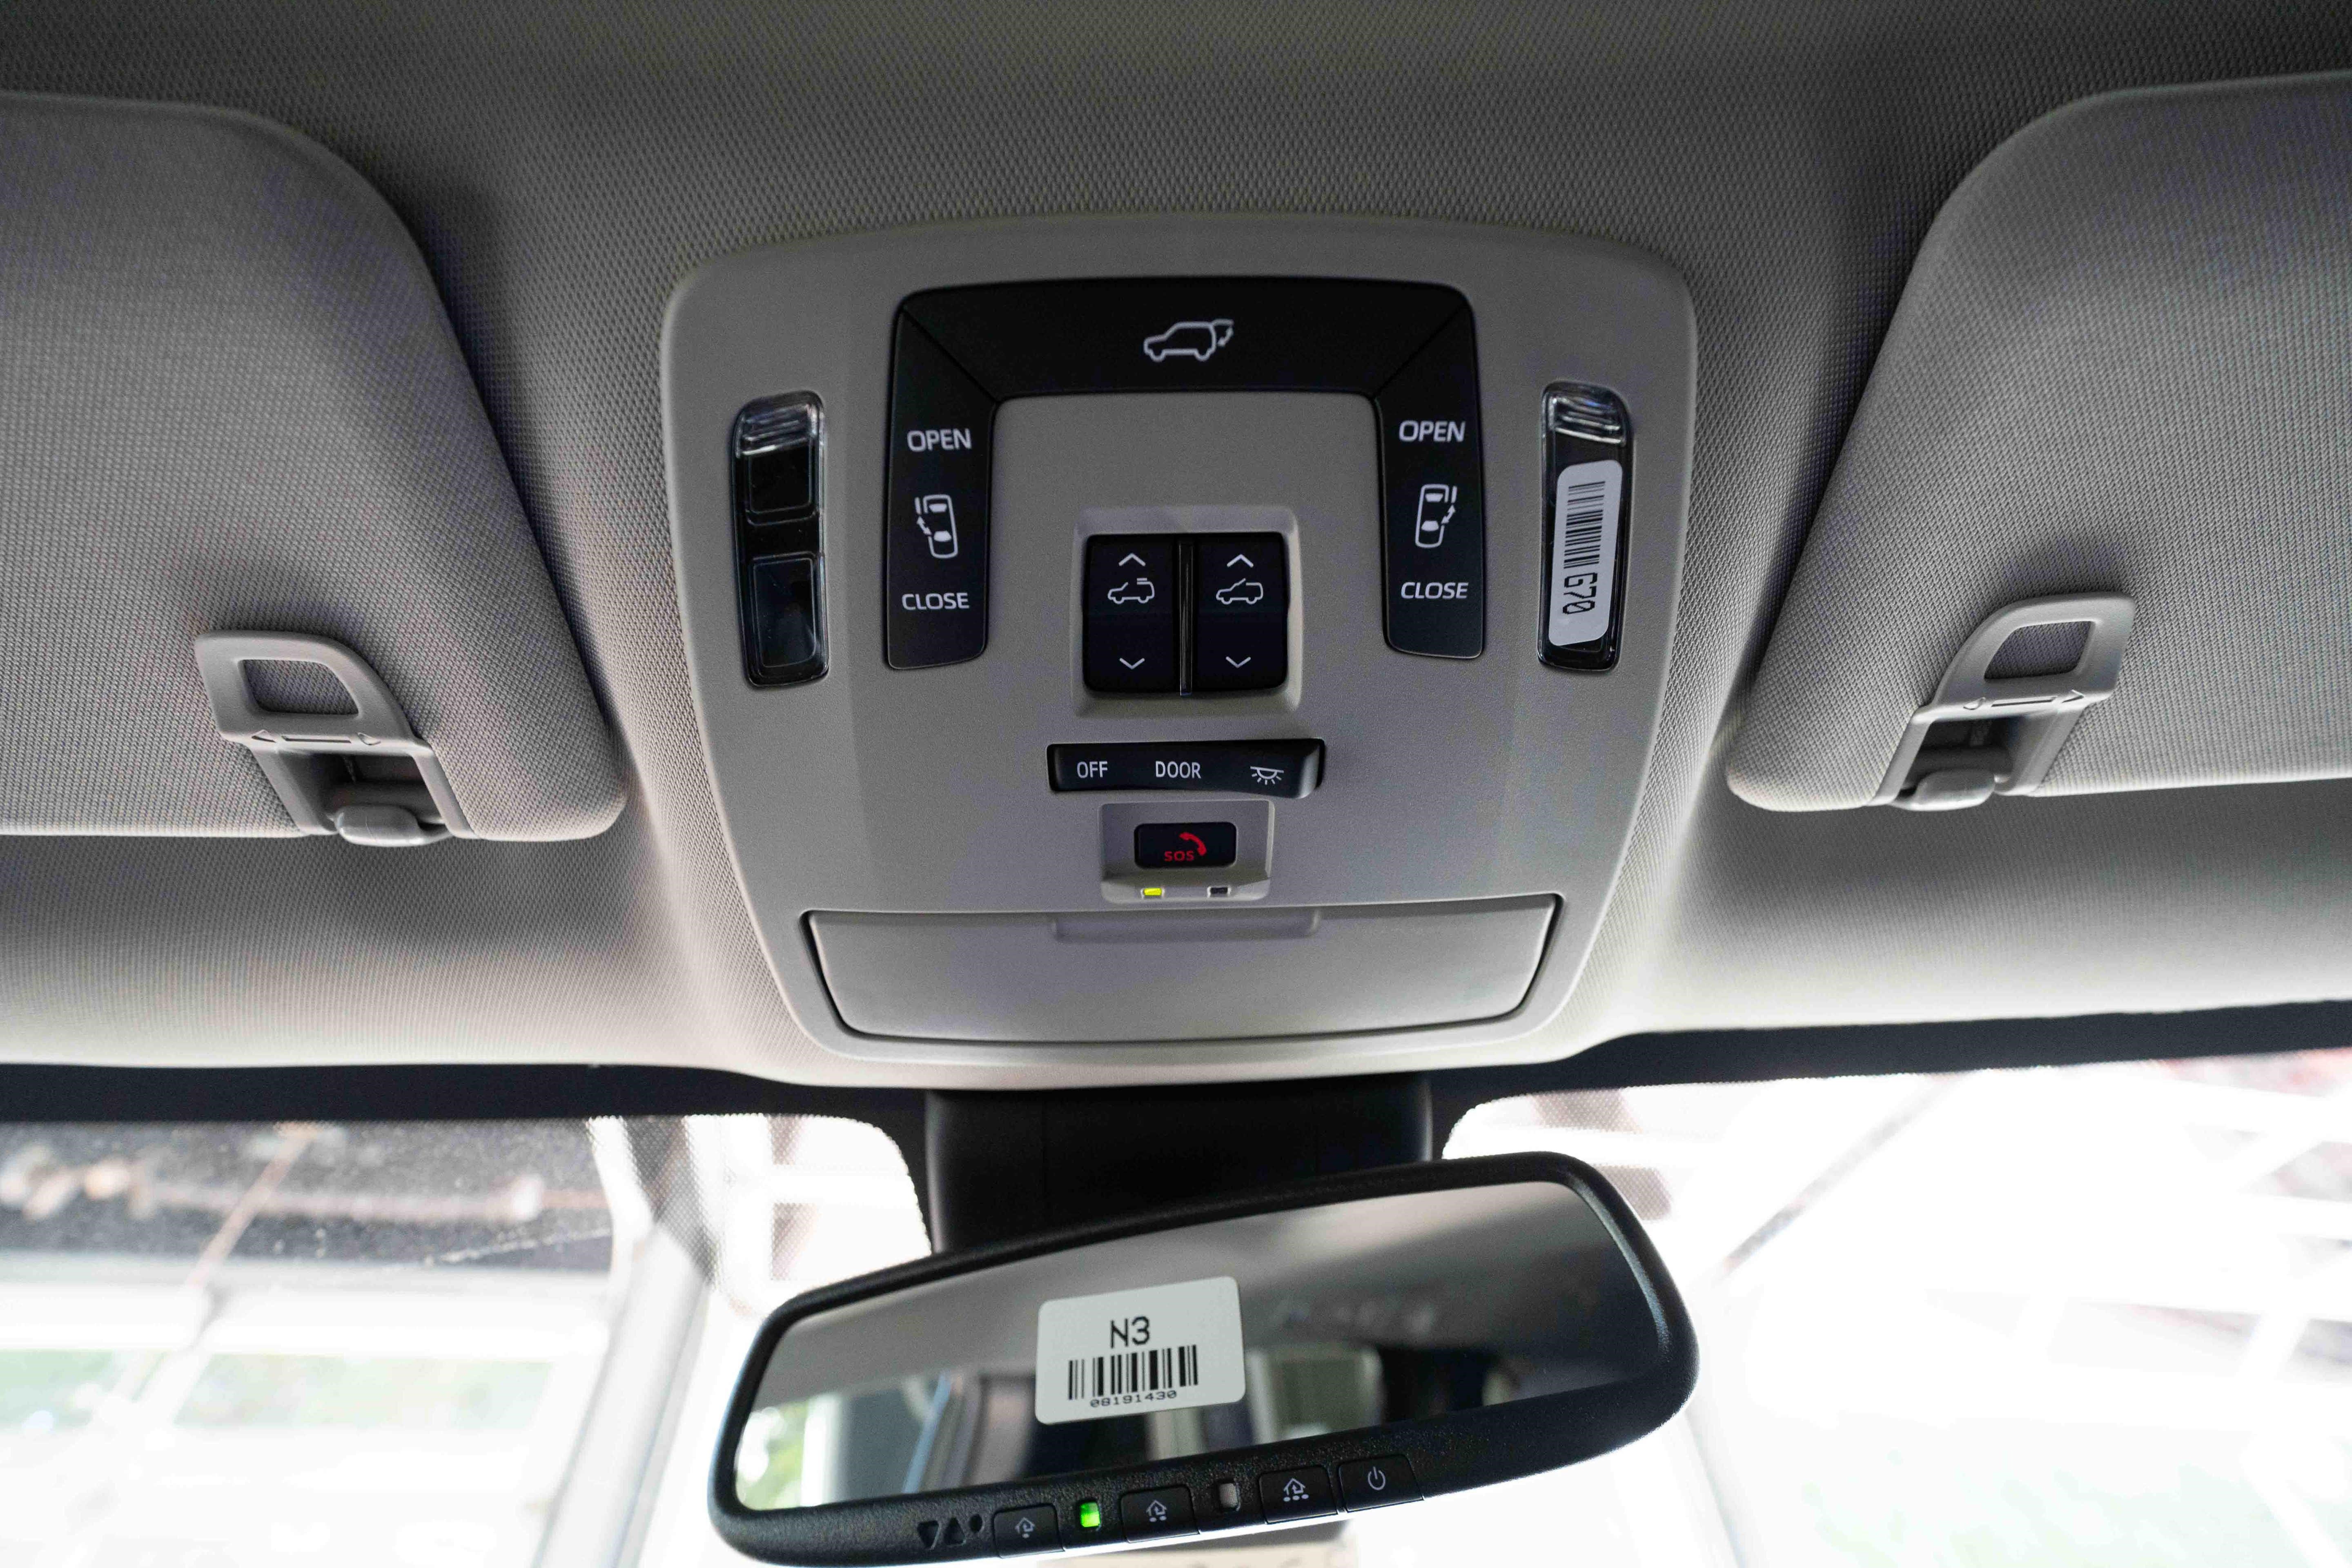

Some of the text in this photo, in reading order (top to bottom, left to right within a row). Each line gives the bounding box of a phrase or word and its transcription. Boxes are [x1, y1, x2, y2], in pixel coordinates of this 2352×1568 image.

[907, 428, 971, 452] OPEN
[1399, 420, 1465, 442] OPEN
[1401, 582, 1469, 599] CLOSE
[1562, 572, 1598, 615] G70
[902, 592, 970, 610] CLOSE
[1076, 761, 1108, 778] OFF
[1155, 761, 1201, 779] DOOR
[1164, 850, 1195, 862] SOS
[1111, 1316, 1150, 1349] N3
[1090, 1390, 1177, 1408] 08191430
